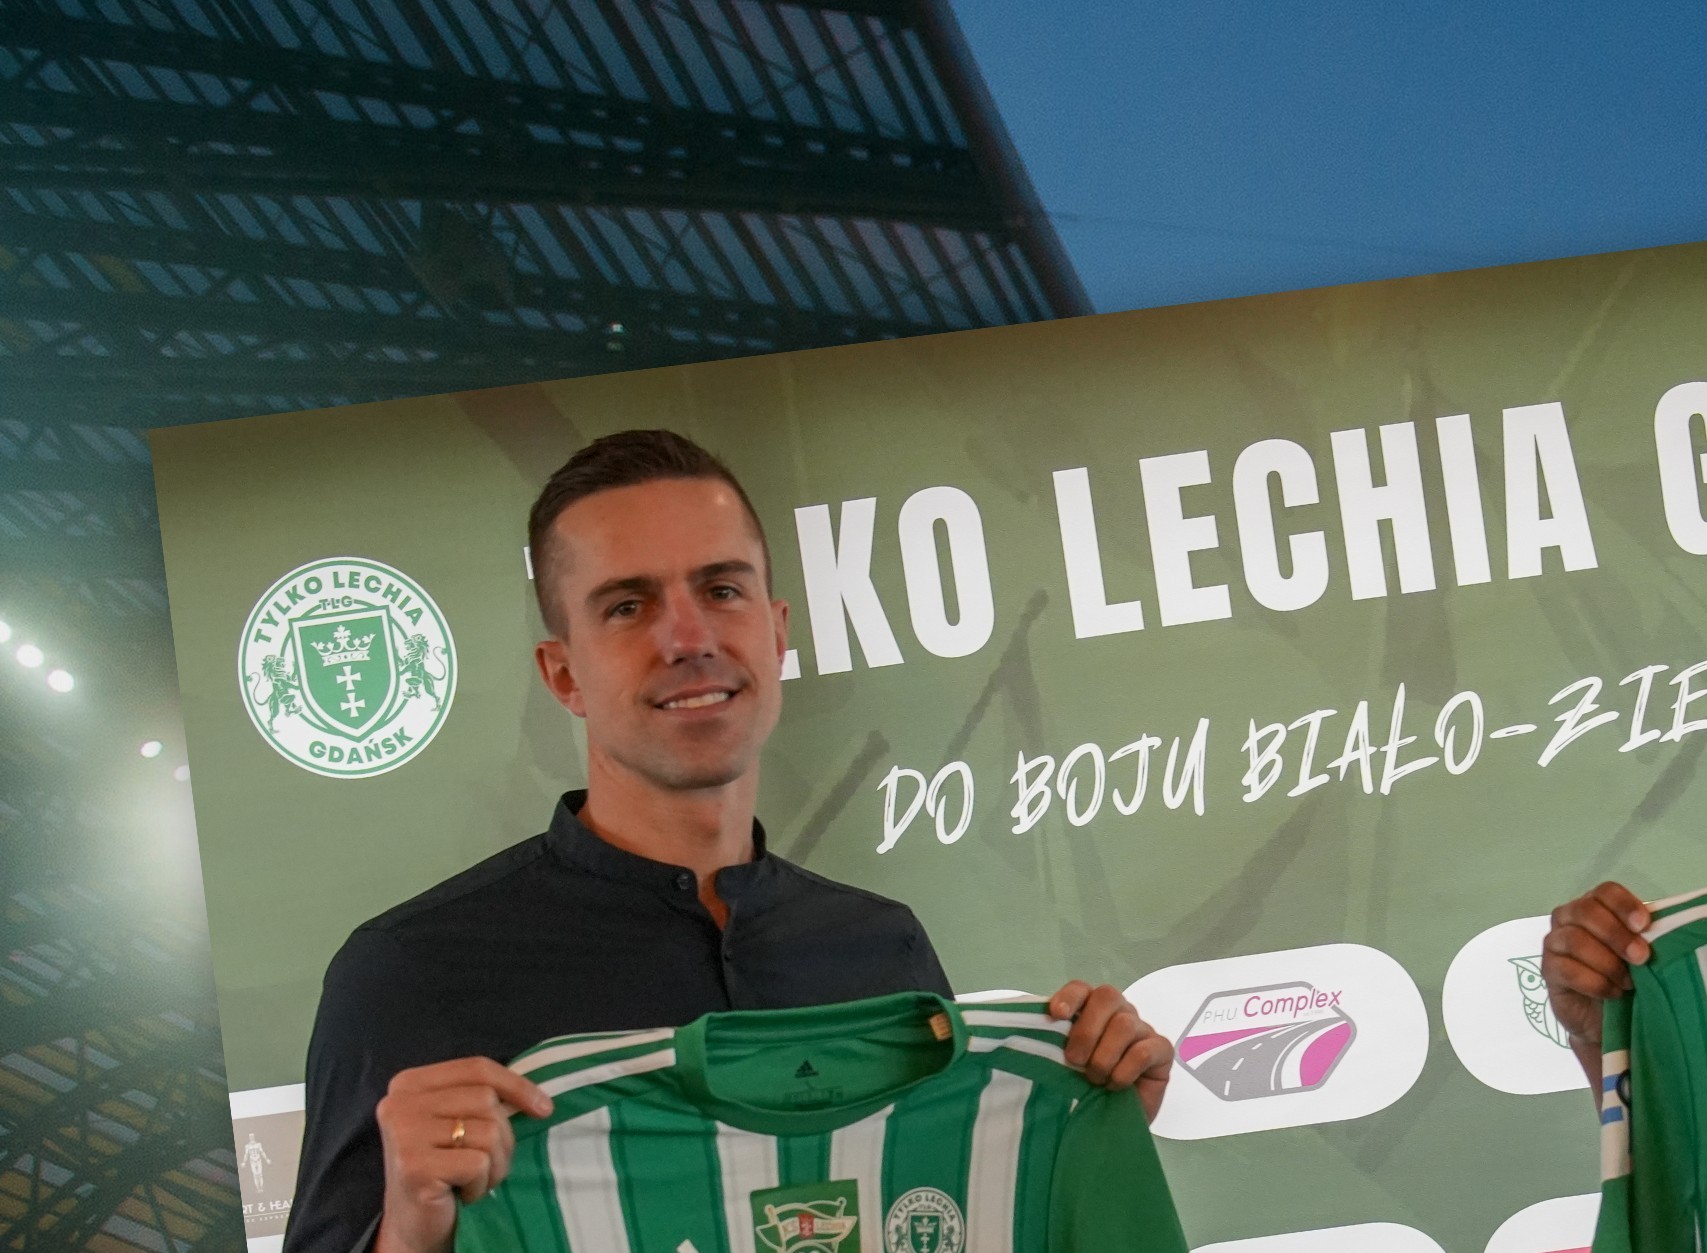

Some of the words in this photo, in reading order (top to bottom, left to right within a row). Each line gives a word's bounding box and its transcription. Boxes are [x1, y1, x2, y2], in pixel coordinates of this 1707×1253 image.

[1052, 402, 1598, 639] LECHIA
[254, 576, 323, 643] TYLKO
[332, 571, 423, 627] LECHIA
[309, 726, 413, 764] GDAŃSK
[876, 761, 974, 854] DO
[1010, 717, 1210, 835] BOJU
[1244, 988, 1342, 1018] Complex
